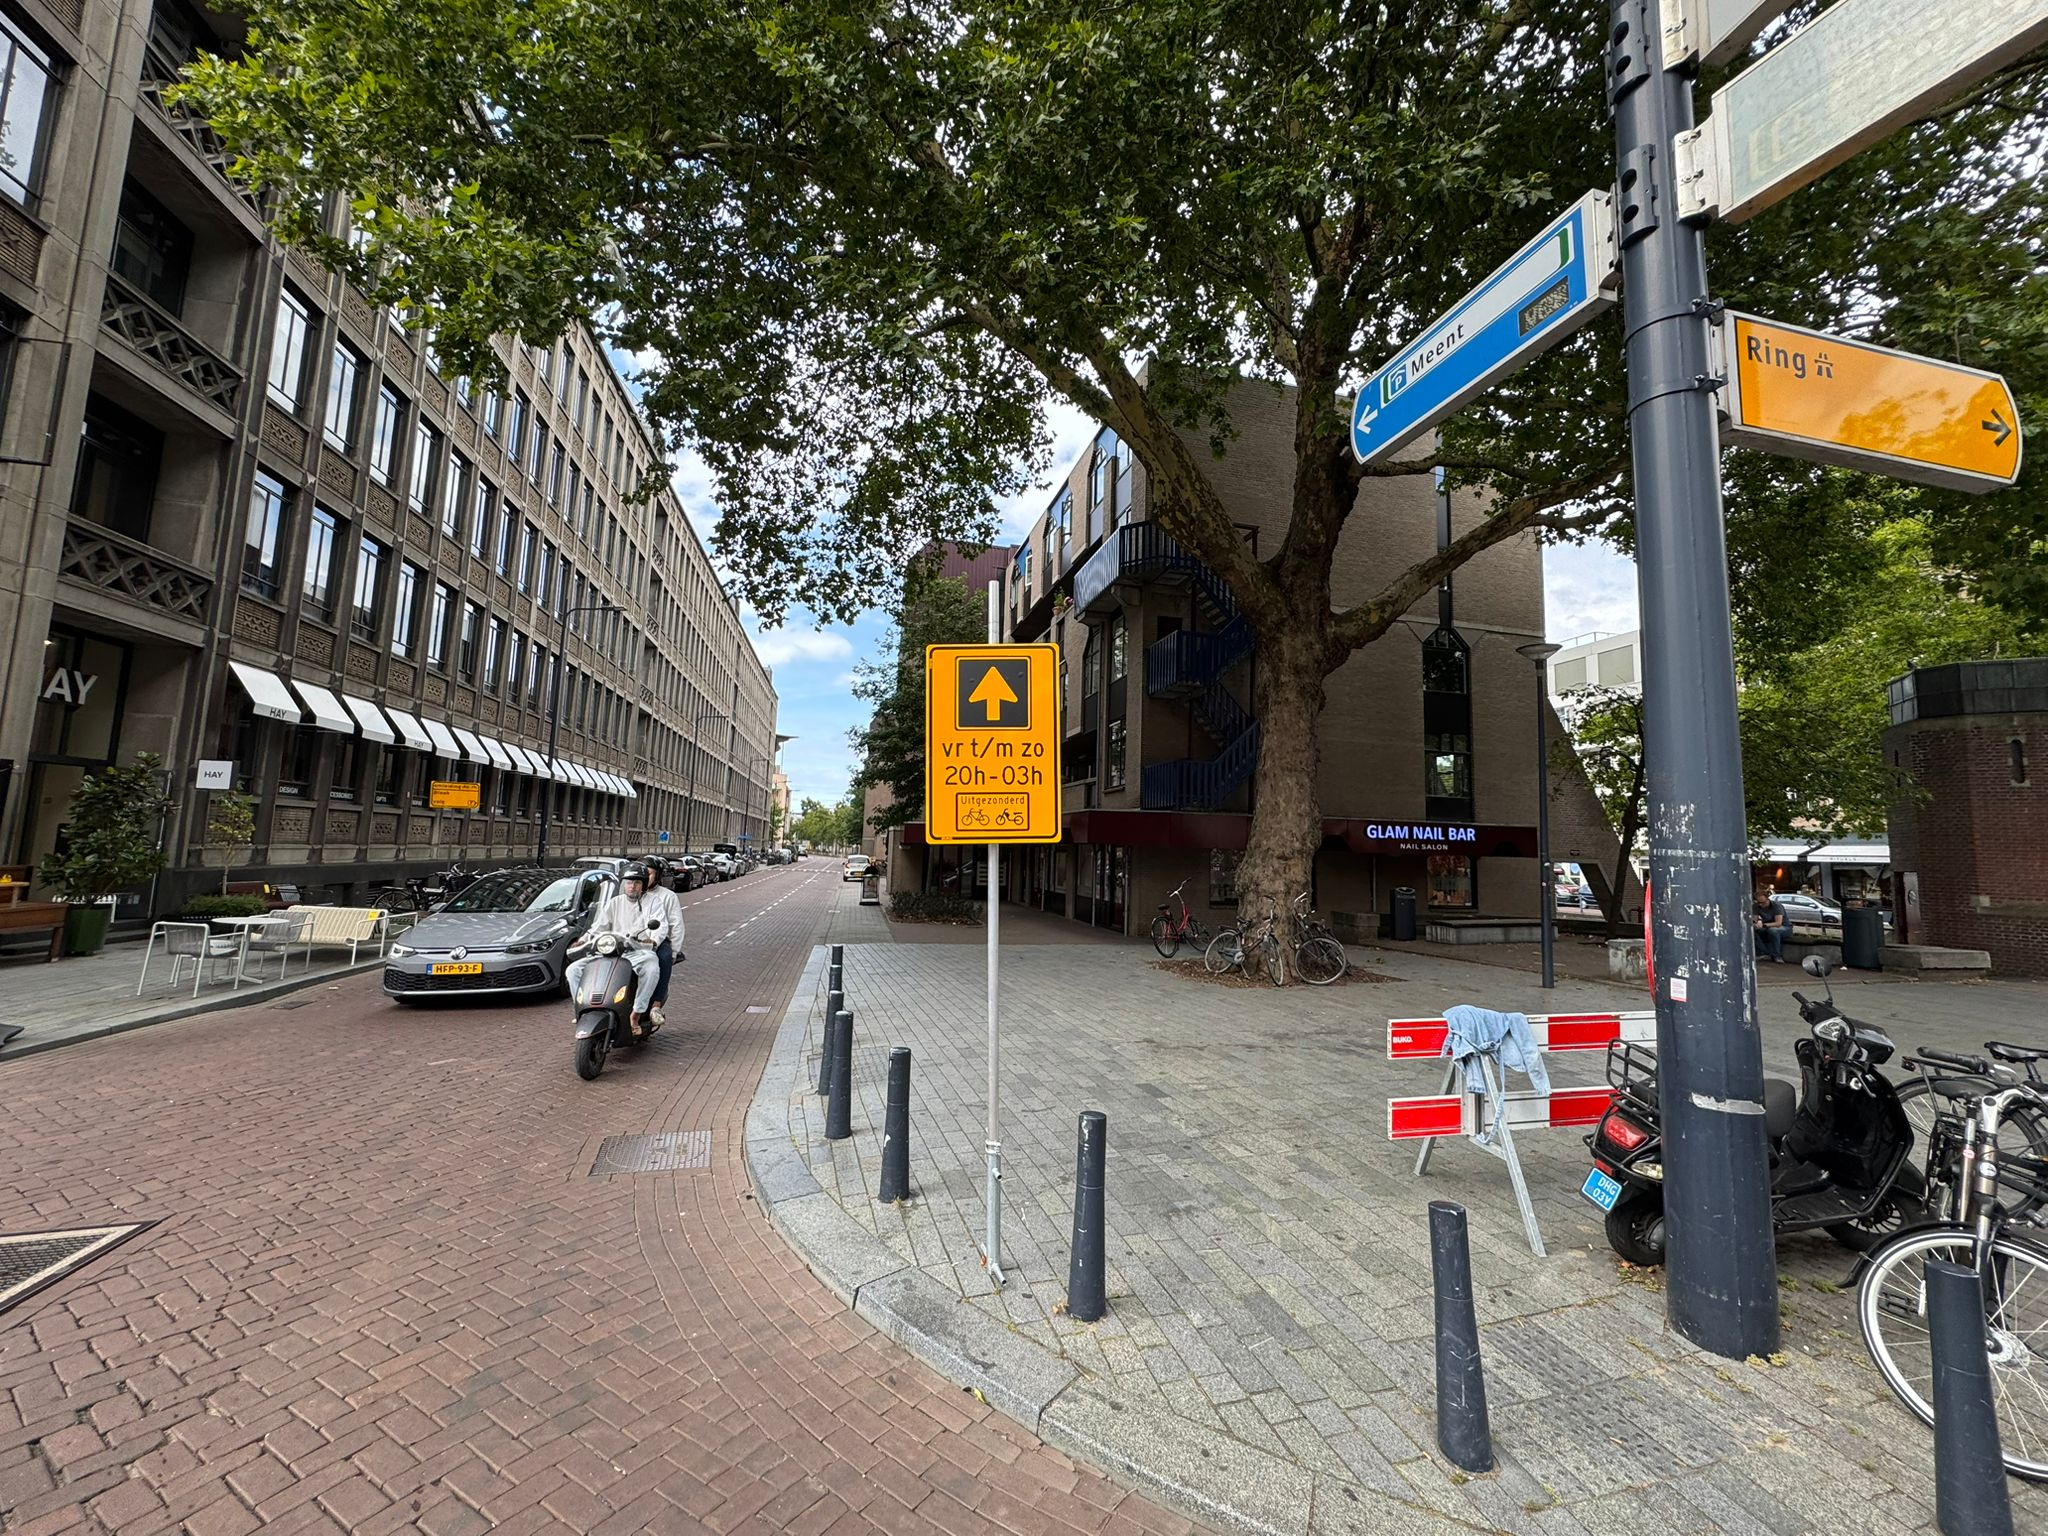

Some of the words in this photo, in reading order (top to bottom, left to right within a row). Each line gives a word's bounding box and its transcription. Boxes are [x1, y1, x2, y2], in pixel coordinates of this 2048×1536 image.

[1411, 323, 1464, 376] Meent
[1747, 335, 1806, 379] Ring
[269, 707, 287, 719] HAY
[942, 742, 963, 757] vr
[970, 737, 1013, 758] t/m
[1021, 742, 1044, 757] zo
[945, 765, 1042, 785] 20h-03h
[279, 786, 298, 794] DESIGN
[960, 796, 1025, 807] Uitgezonderd
[1366, 824, 1409, 839] GLAM
[1413, 826, 1445, 840] NAIL
[1448, 827, 1476, 841] BAR
[435, 964, 478, 973] HFP-93-F
[1597, 1176, 1618, 1196] DHG
[1592, 1188, 1612, 1206] 03V
